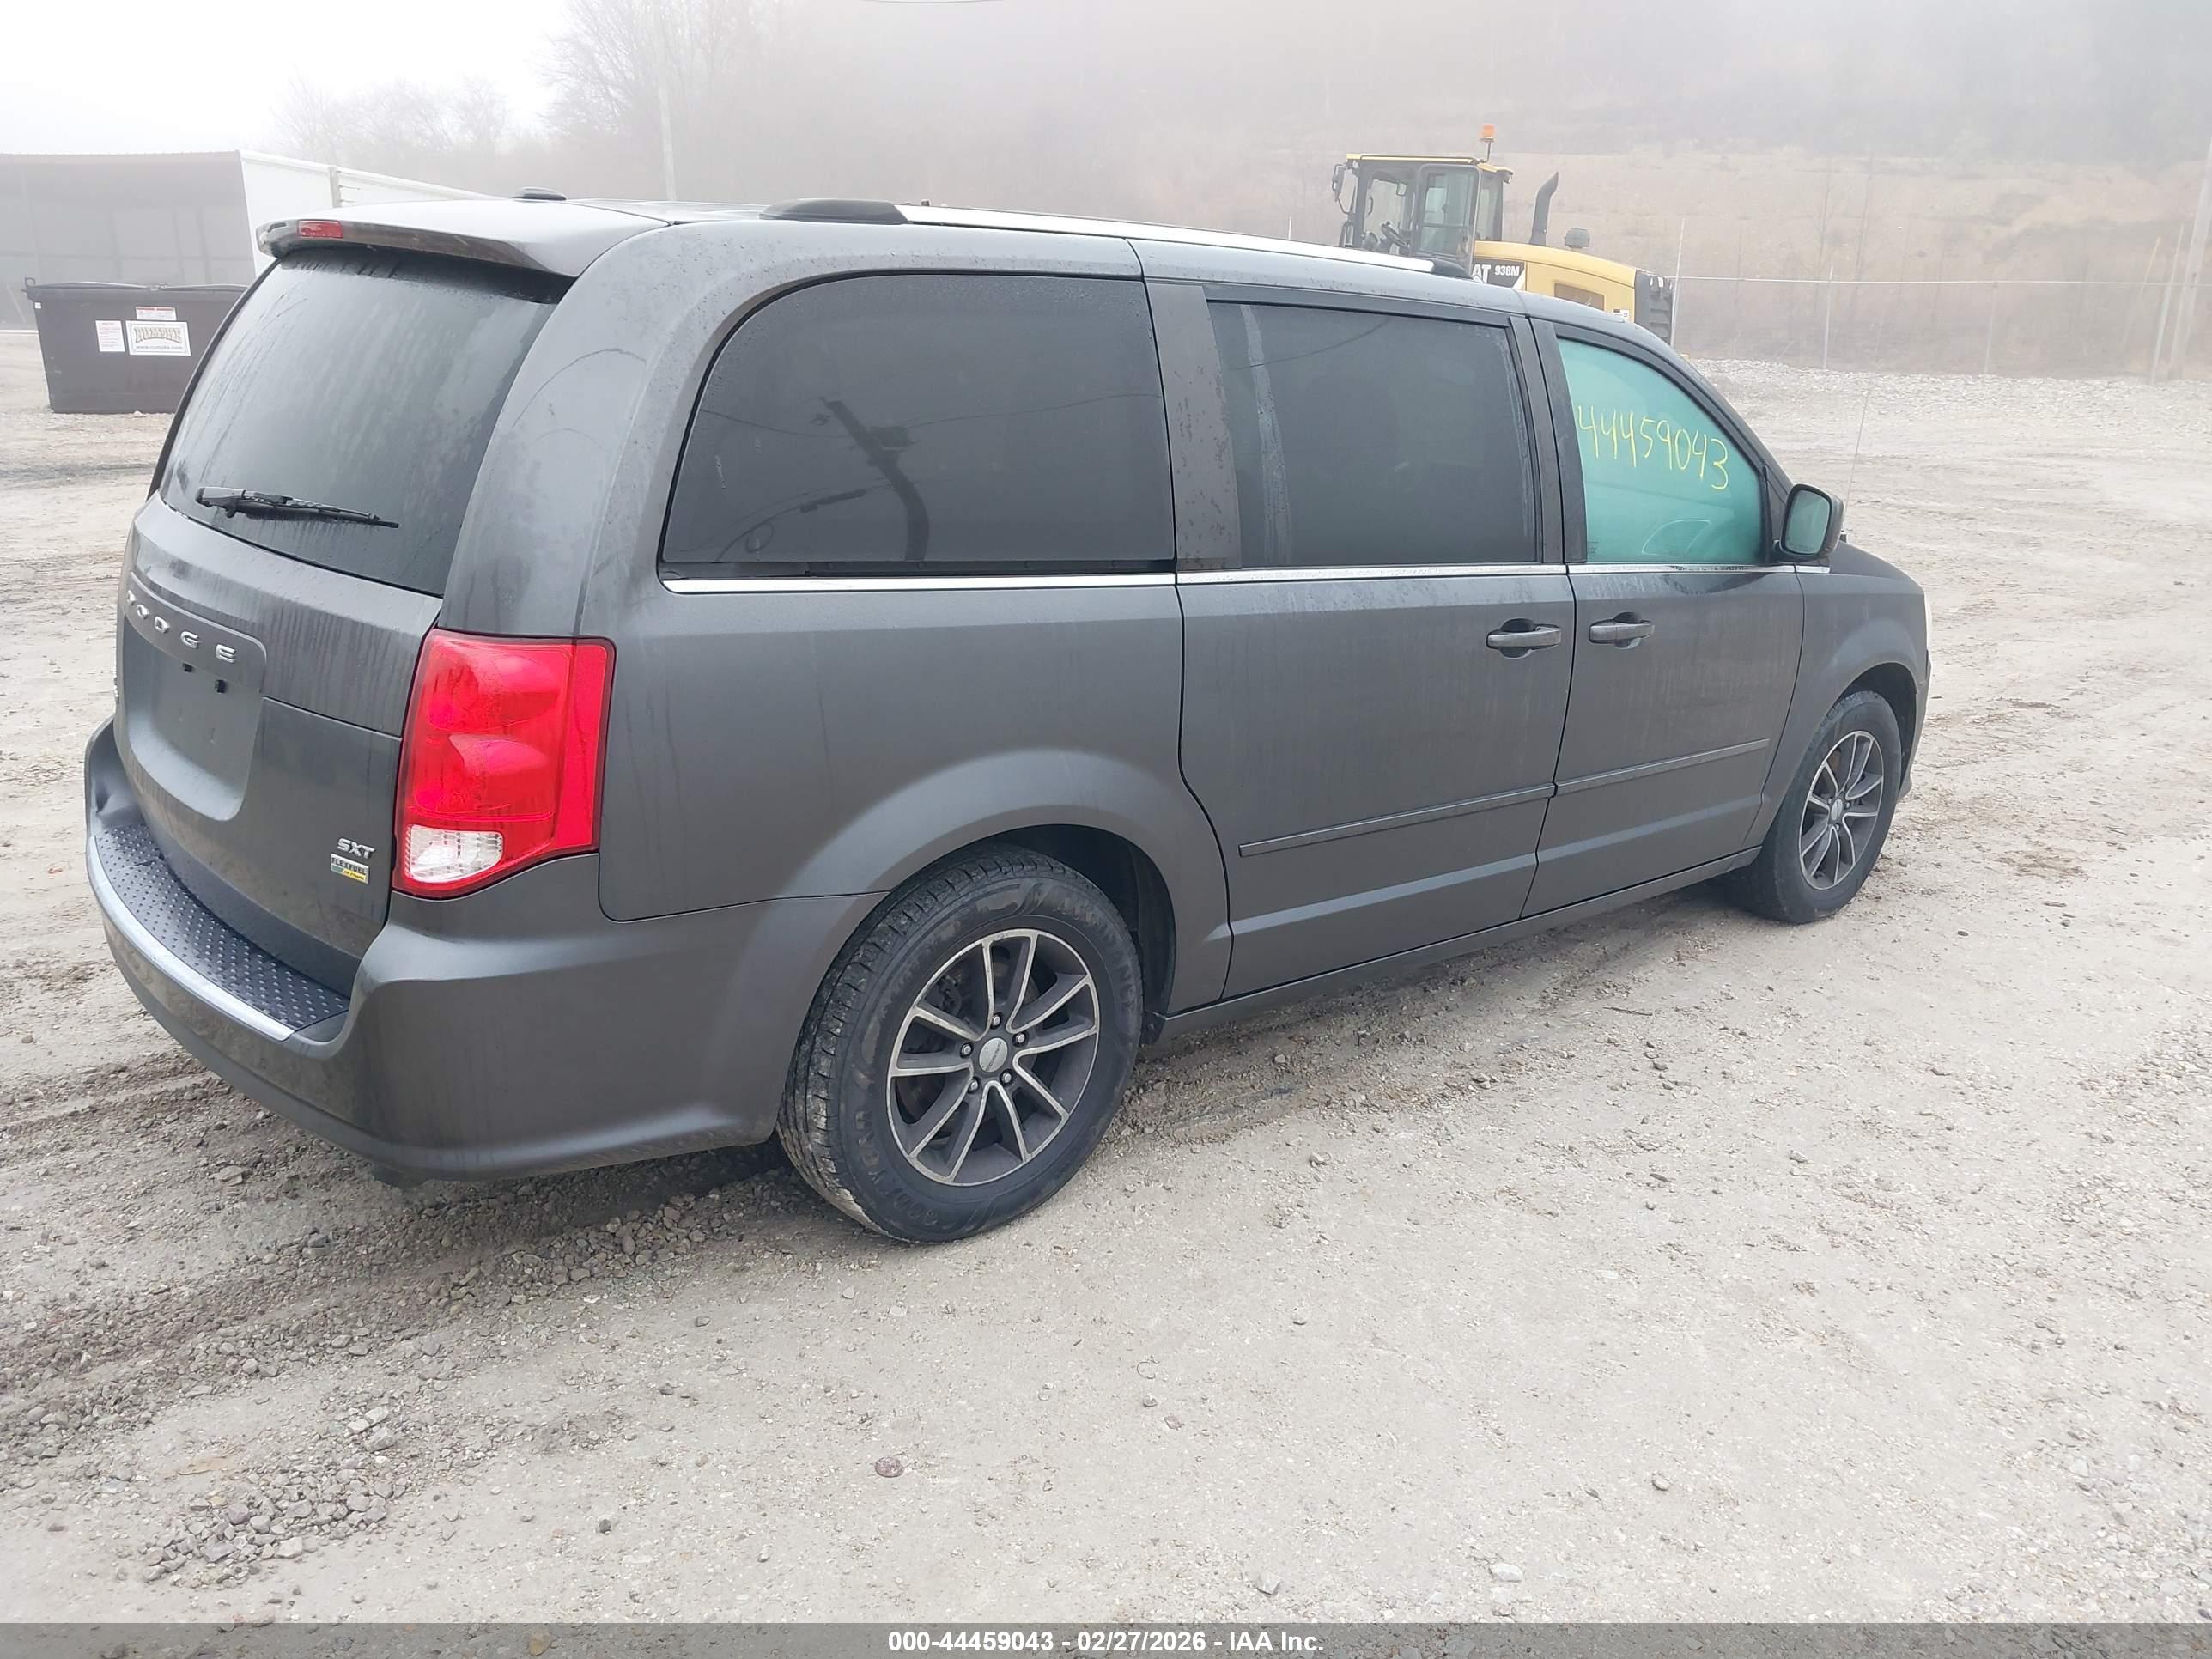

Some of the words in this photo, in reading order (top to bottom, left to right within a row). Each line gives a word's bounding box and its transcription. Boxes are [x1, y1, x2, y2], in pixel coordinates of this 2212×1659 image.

[1494, 264, 1520, 276] 938M
[1577, 405, 1729, 489] 44459043
[337, 837, 375, 859] SXT
